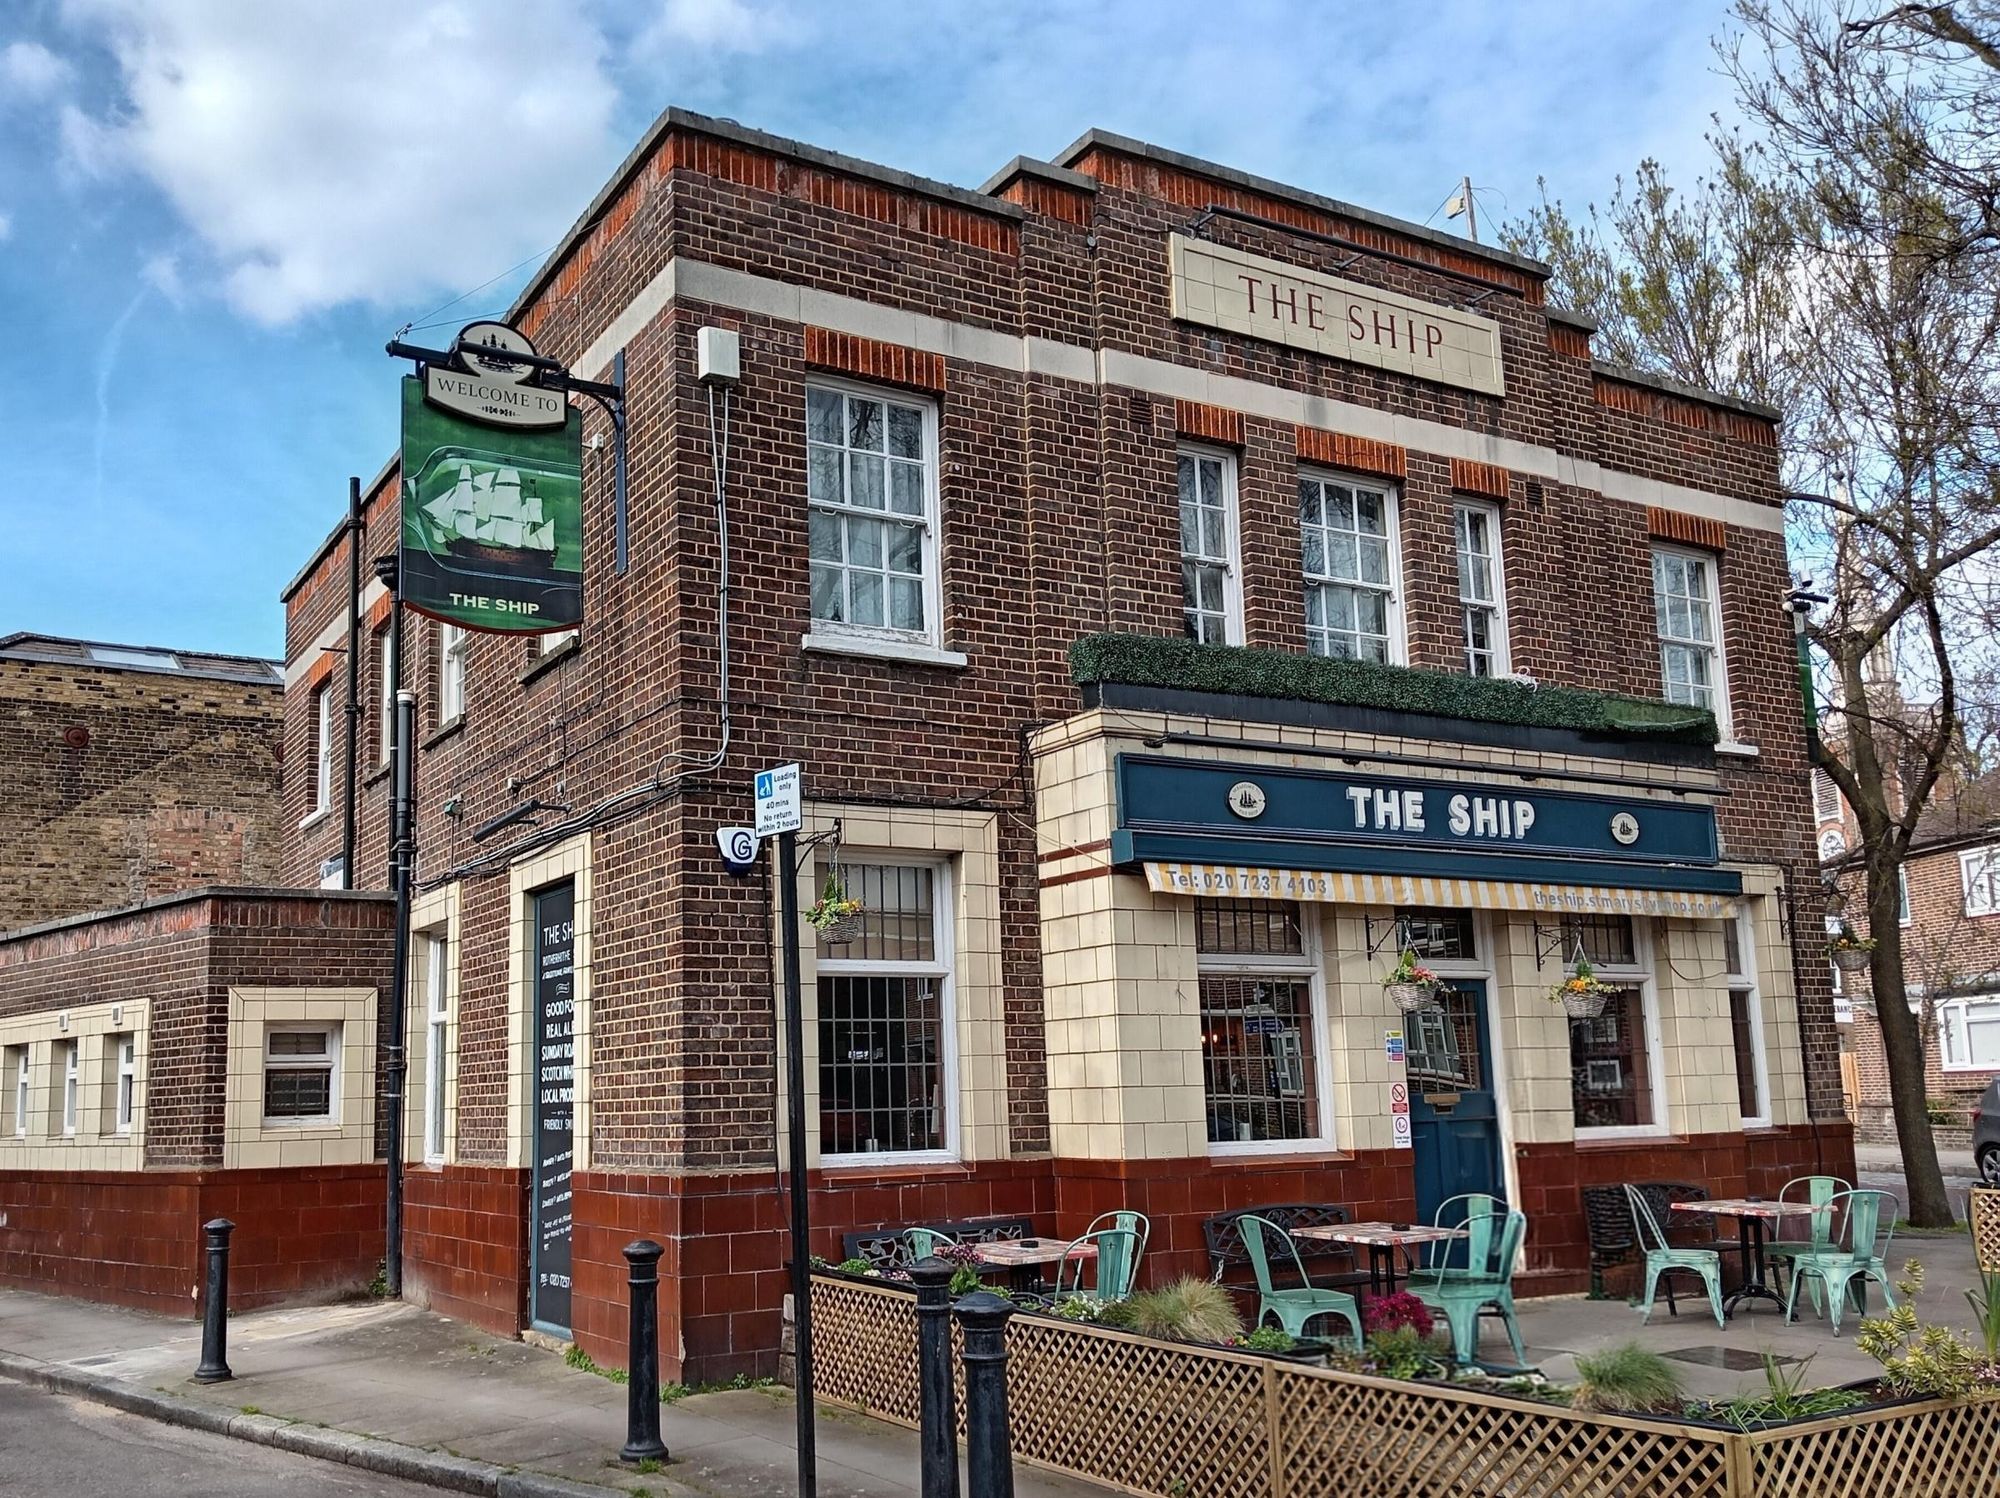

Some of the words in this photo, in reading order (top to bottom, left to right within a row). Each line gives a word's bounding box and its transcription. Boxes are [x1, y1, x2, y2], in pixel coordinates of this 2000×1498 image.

[1238, 275, 1325, 332] THE
[1348, 304, 1443, 358] SHIP
[438, 378, 530, 408] WELCOME
[535, 395, 559, 412] TO
[449, 592, 490, 611] THE
[495, 598, 540, 616] SHIP
[774, 771, 796, 782] Loading
[779, 782, 791, 791] only
[766, 801, 775, 809] 40
[775, 799, 789, 808] mins
[1345, 785, 1426, 833] THE
[1447, 791, 1537, 840] SHIP
[763, 814, 773, 823] No
[773, 811, 793, 820] return
[776, 821, 782, 829] 2
[782, 818, 799, 828] hours
[1165, 870, 1200, 888] Tel:
[1203, 873, 1234, 889] 020
[1240, 874, 1281, 891] 7237
[1287, 877, 1327, 895] 4103
[543, 924, 560, 946] THE
[545, 1001, 565, 1018] GOOD
[565, 999, 575, 1014] FO
[546, 1022, 562, 1039] REAL
[541, 1044, 563, 1061] SUNDAY
[541, 1066, 563, 1082] SCOTCH
[541, 1088, 559, 1104] LOCAL
